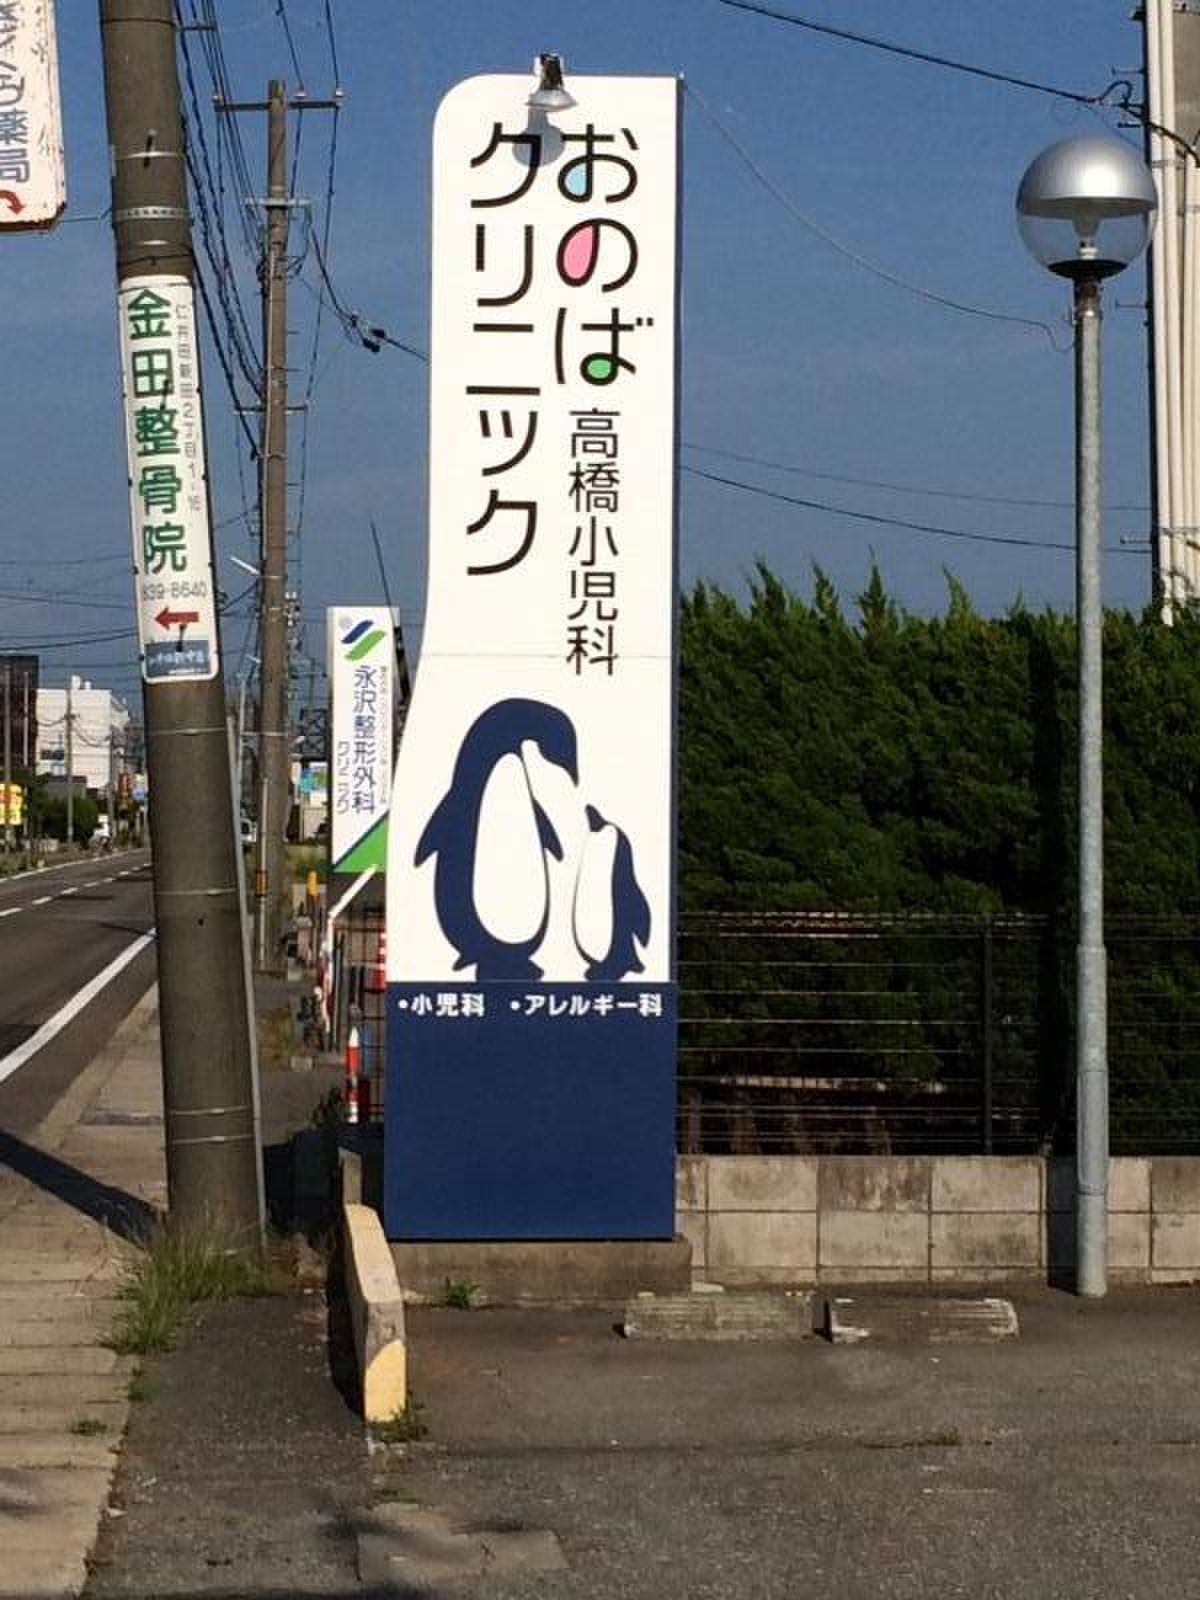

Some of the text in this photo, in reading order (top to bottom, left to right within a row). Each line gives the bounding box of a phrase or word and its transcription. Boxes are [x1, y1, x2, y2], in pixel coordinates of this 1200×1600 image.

[466, 122, 542, 577] クリニック
[555, 123, 654, 386] おのば
[127, 289, 187, 575] 金田整骨院
[566, 407, 621, 676] 高橋小児科
[352, 665, 378, 815] 永沢整形外科
